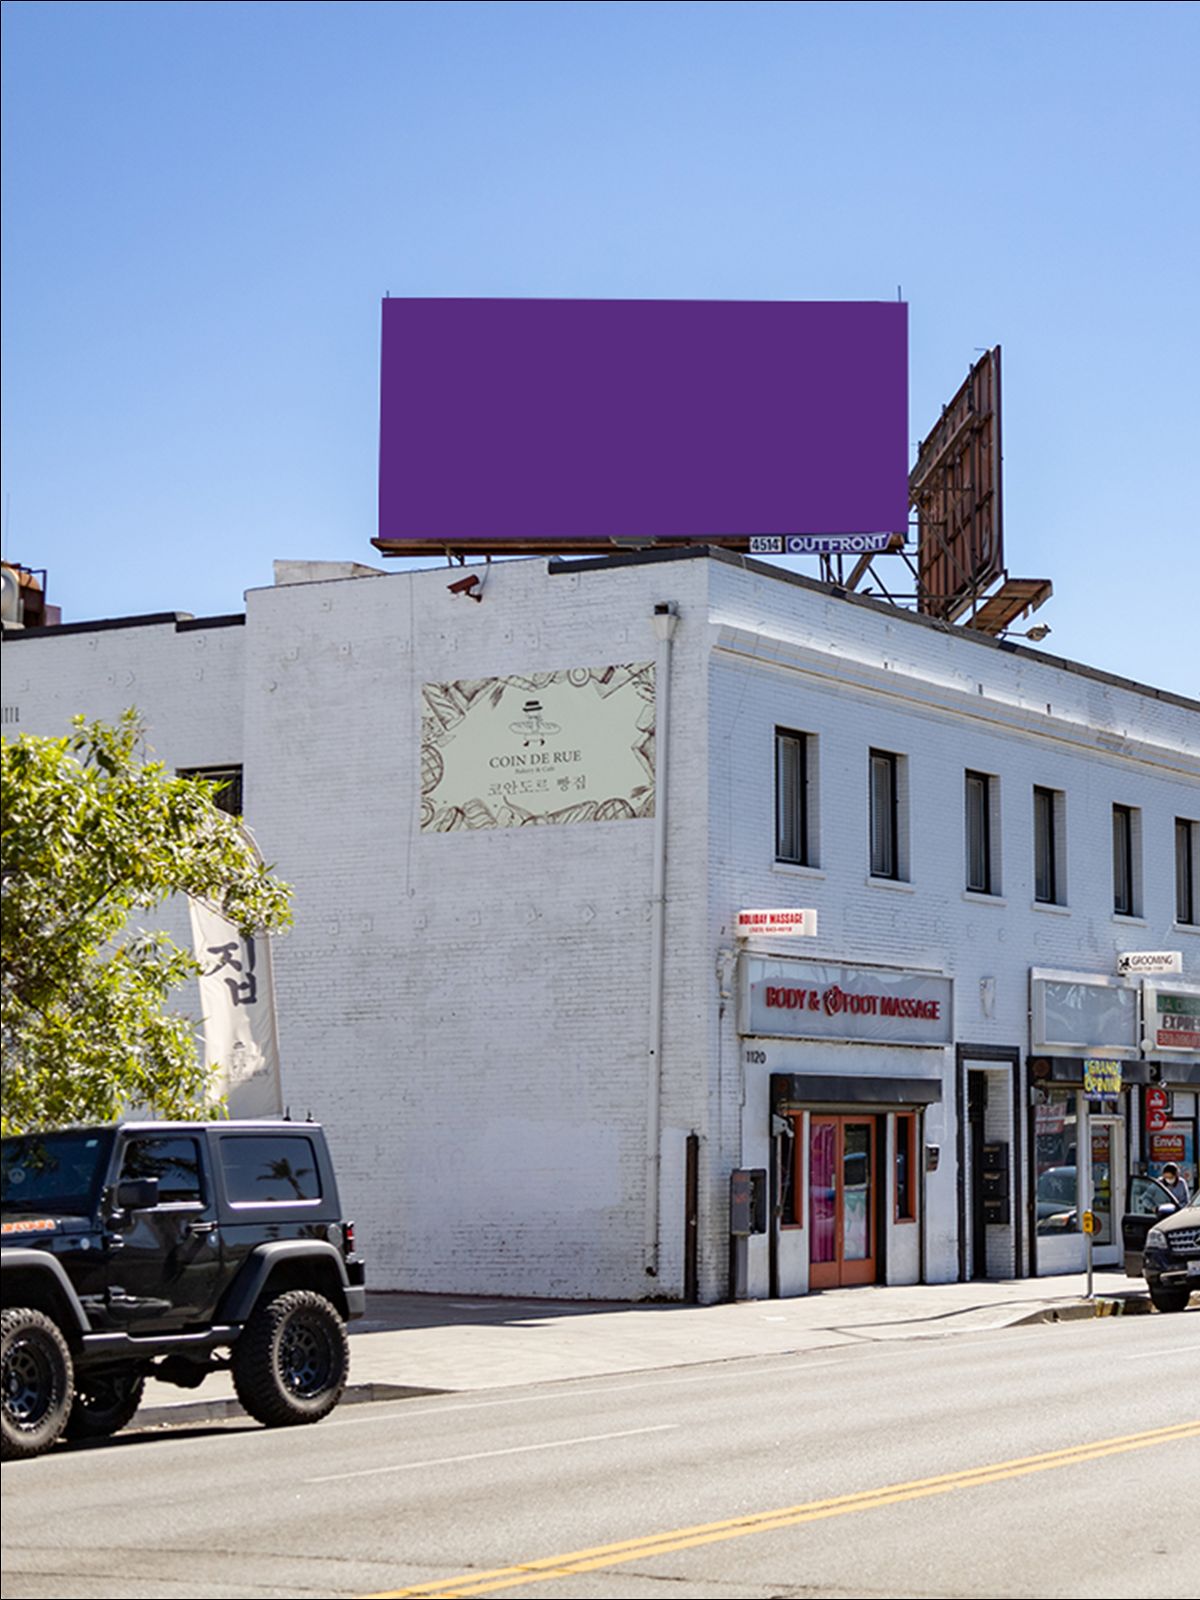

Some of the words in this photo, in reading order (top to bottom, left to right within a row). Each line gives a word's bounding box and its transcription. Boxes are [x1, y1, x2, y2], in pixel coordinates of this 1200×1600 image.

[751, 537, 780, 552] 4514
[790, 534, 887, 552] OUTFRONT
[489, 754, 526, 768] COIN
[530, 752, 550, 765] DE
[553, 750, 582, 763] RUE
[557, 774, 586, 792] 빵집
[769, 912, 803, 924] MASSAGE
[1131, 954, 1174, 966] GROOMING
[766, 986, 807, 1011] BODY
[809, 990, 820, 1011] &
[842, 993, 878, 1015] FOOT
[880, 997, 940, 1020] MASSAGE
[746, 1051, 767, 1064] 1120
[1088, 1060, 1119, 1075] GRAND
[1153, 1134, 1183, 1148] Envía
